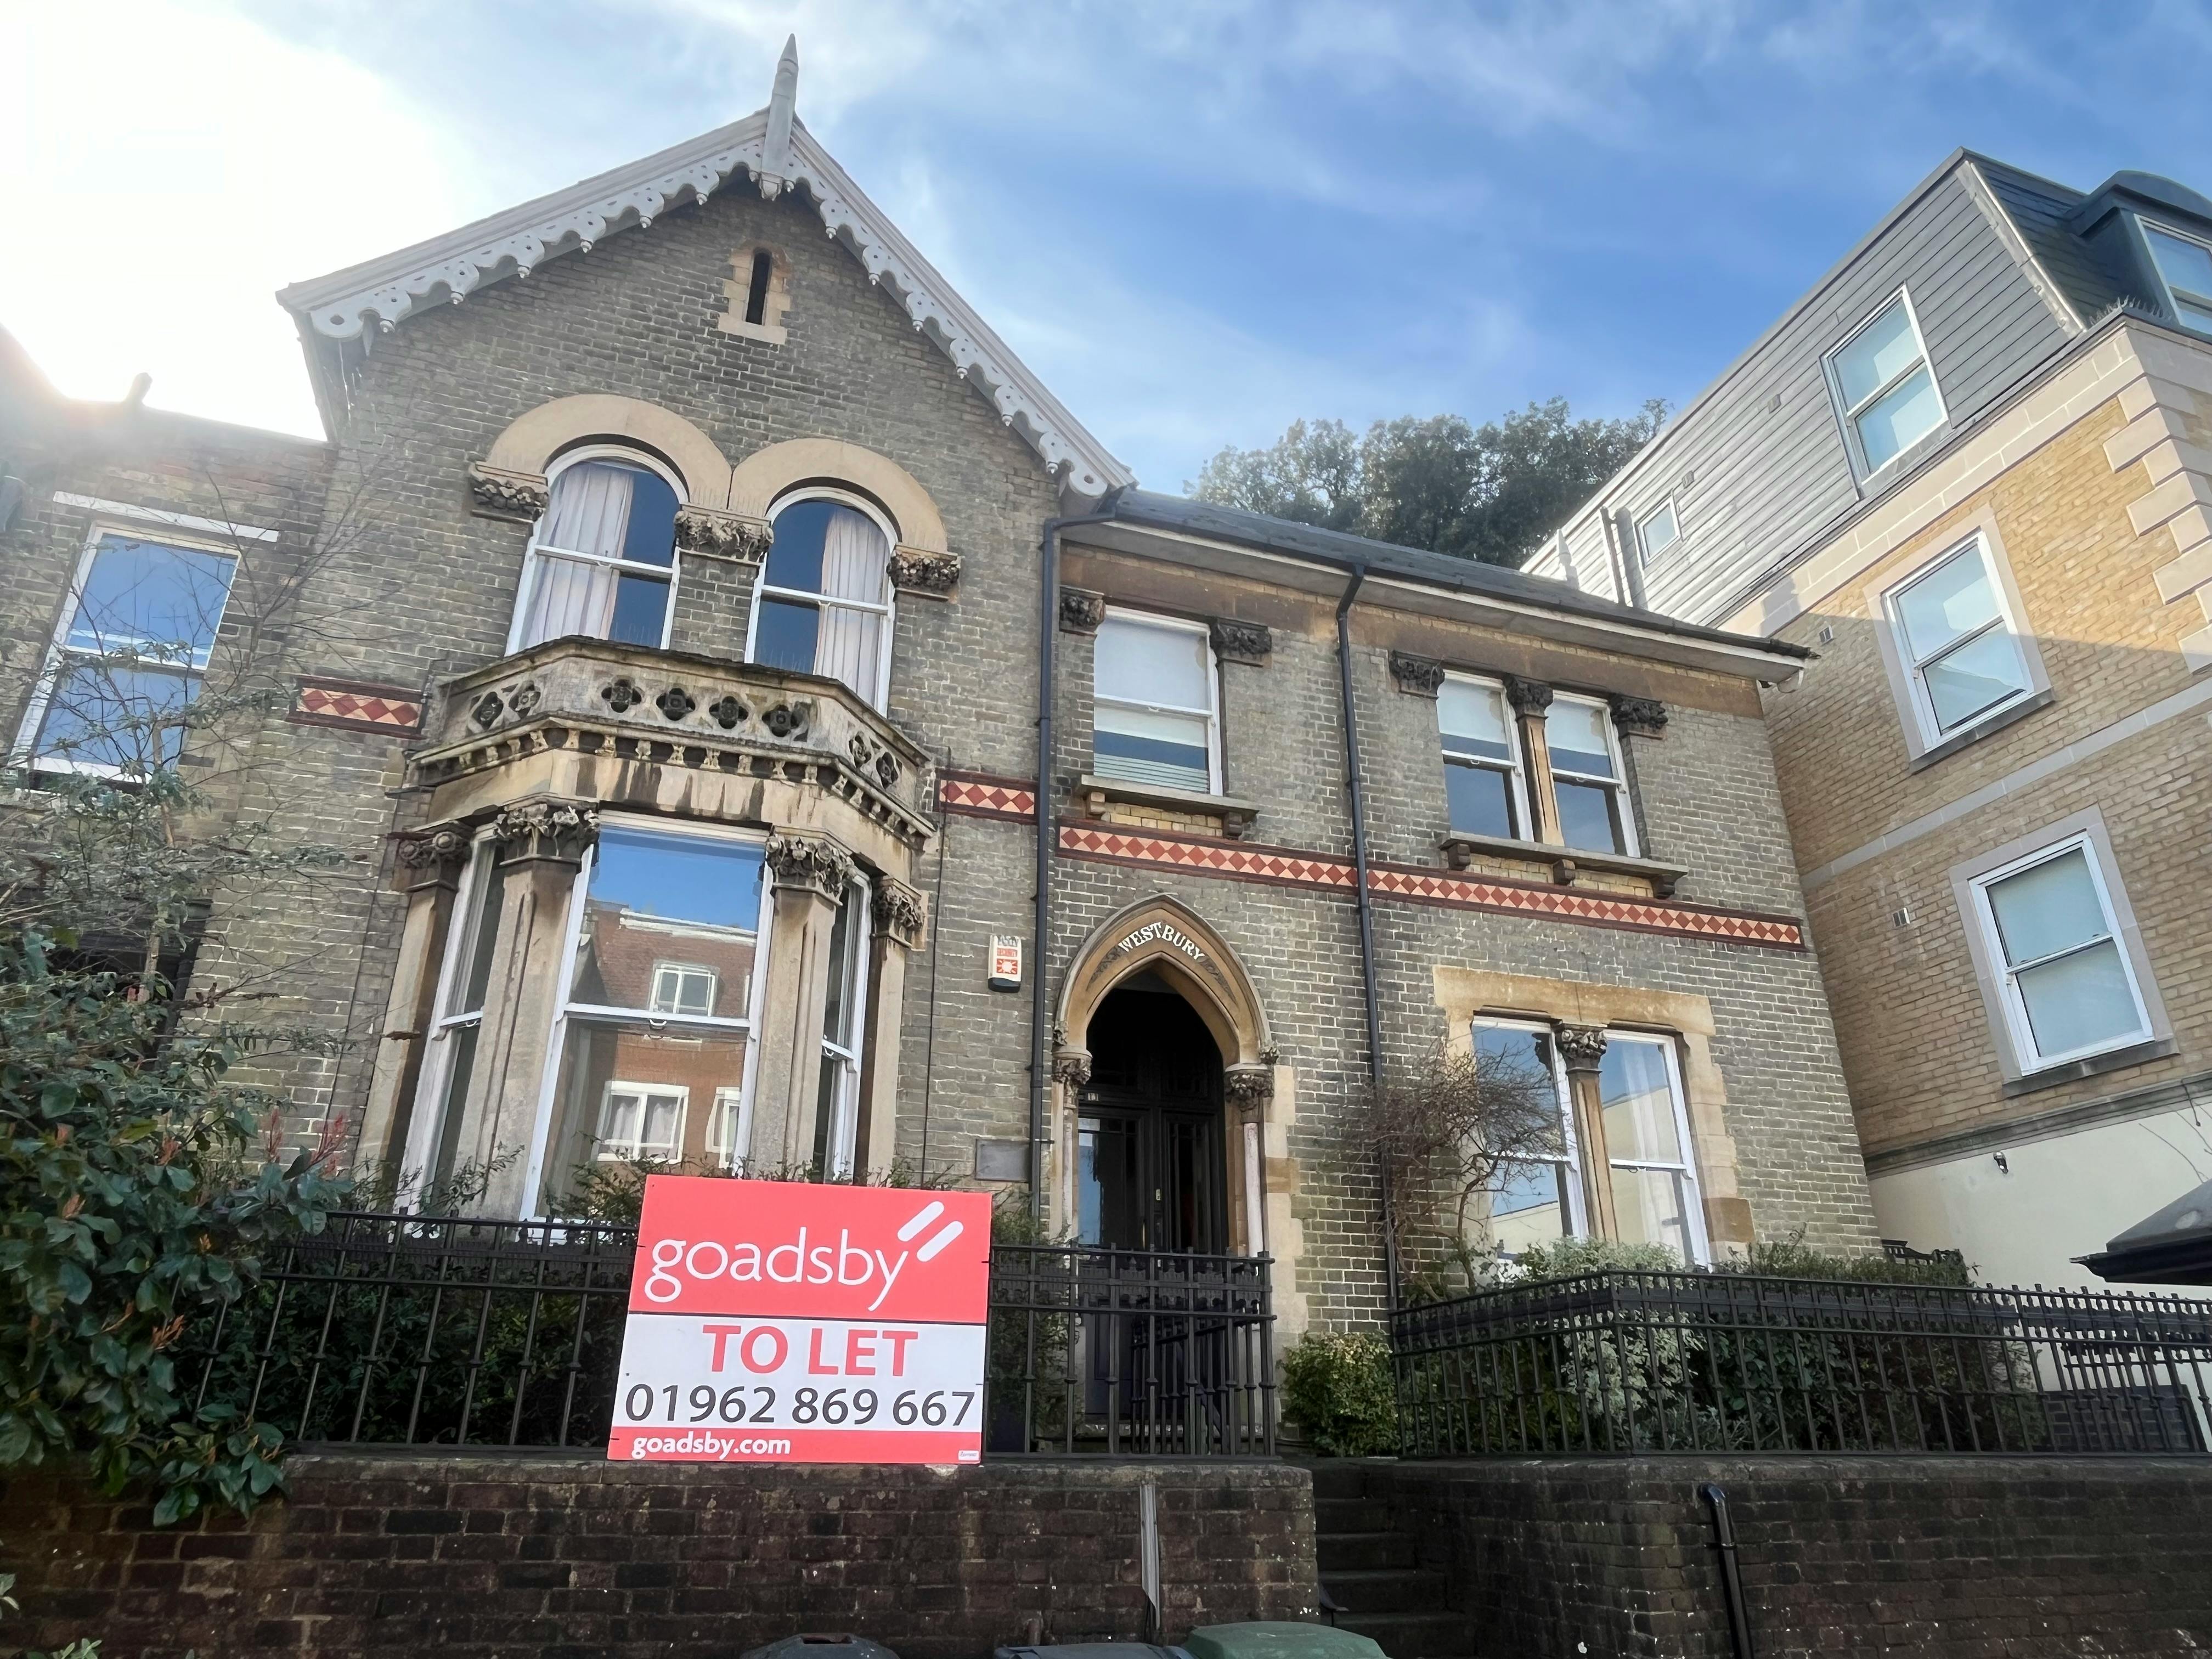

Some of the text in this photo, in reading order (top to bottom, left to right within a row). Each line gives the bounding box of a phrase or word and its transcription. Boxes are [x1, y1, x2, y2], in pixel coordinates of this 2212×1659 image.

[1118, 922, 1205, 960] WESTBURY
[644, 1226, 909, 1311] goadsby
[703, 1324, 918, 1376] TO LET
[626, 1384, 975, 1426] 01962 869 667
[631, 1431, 791, 1460] goadsby.com
